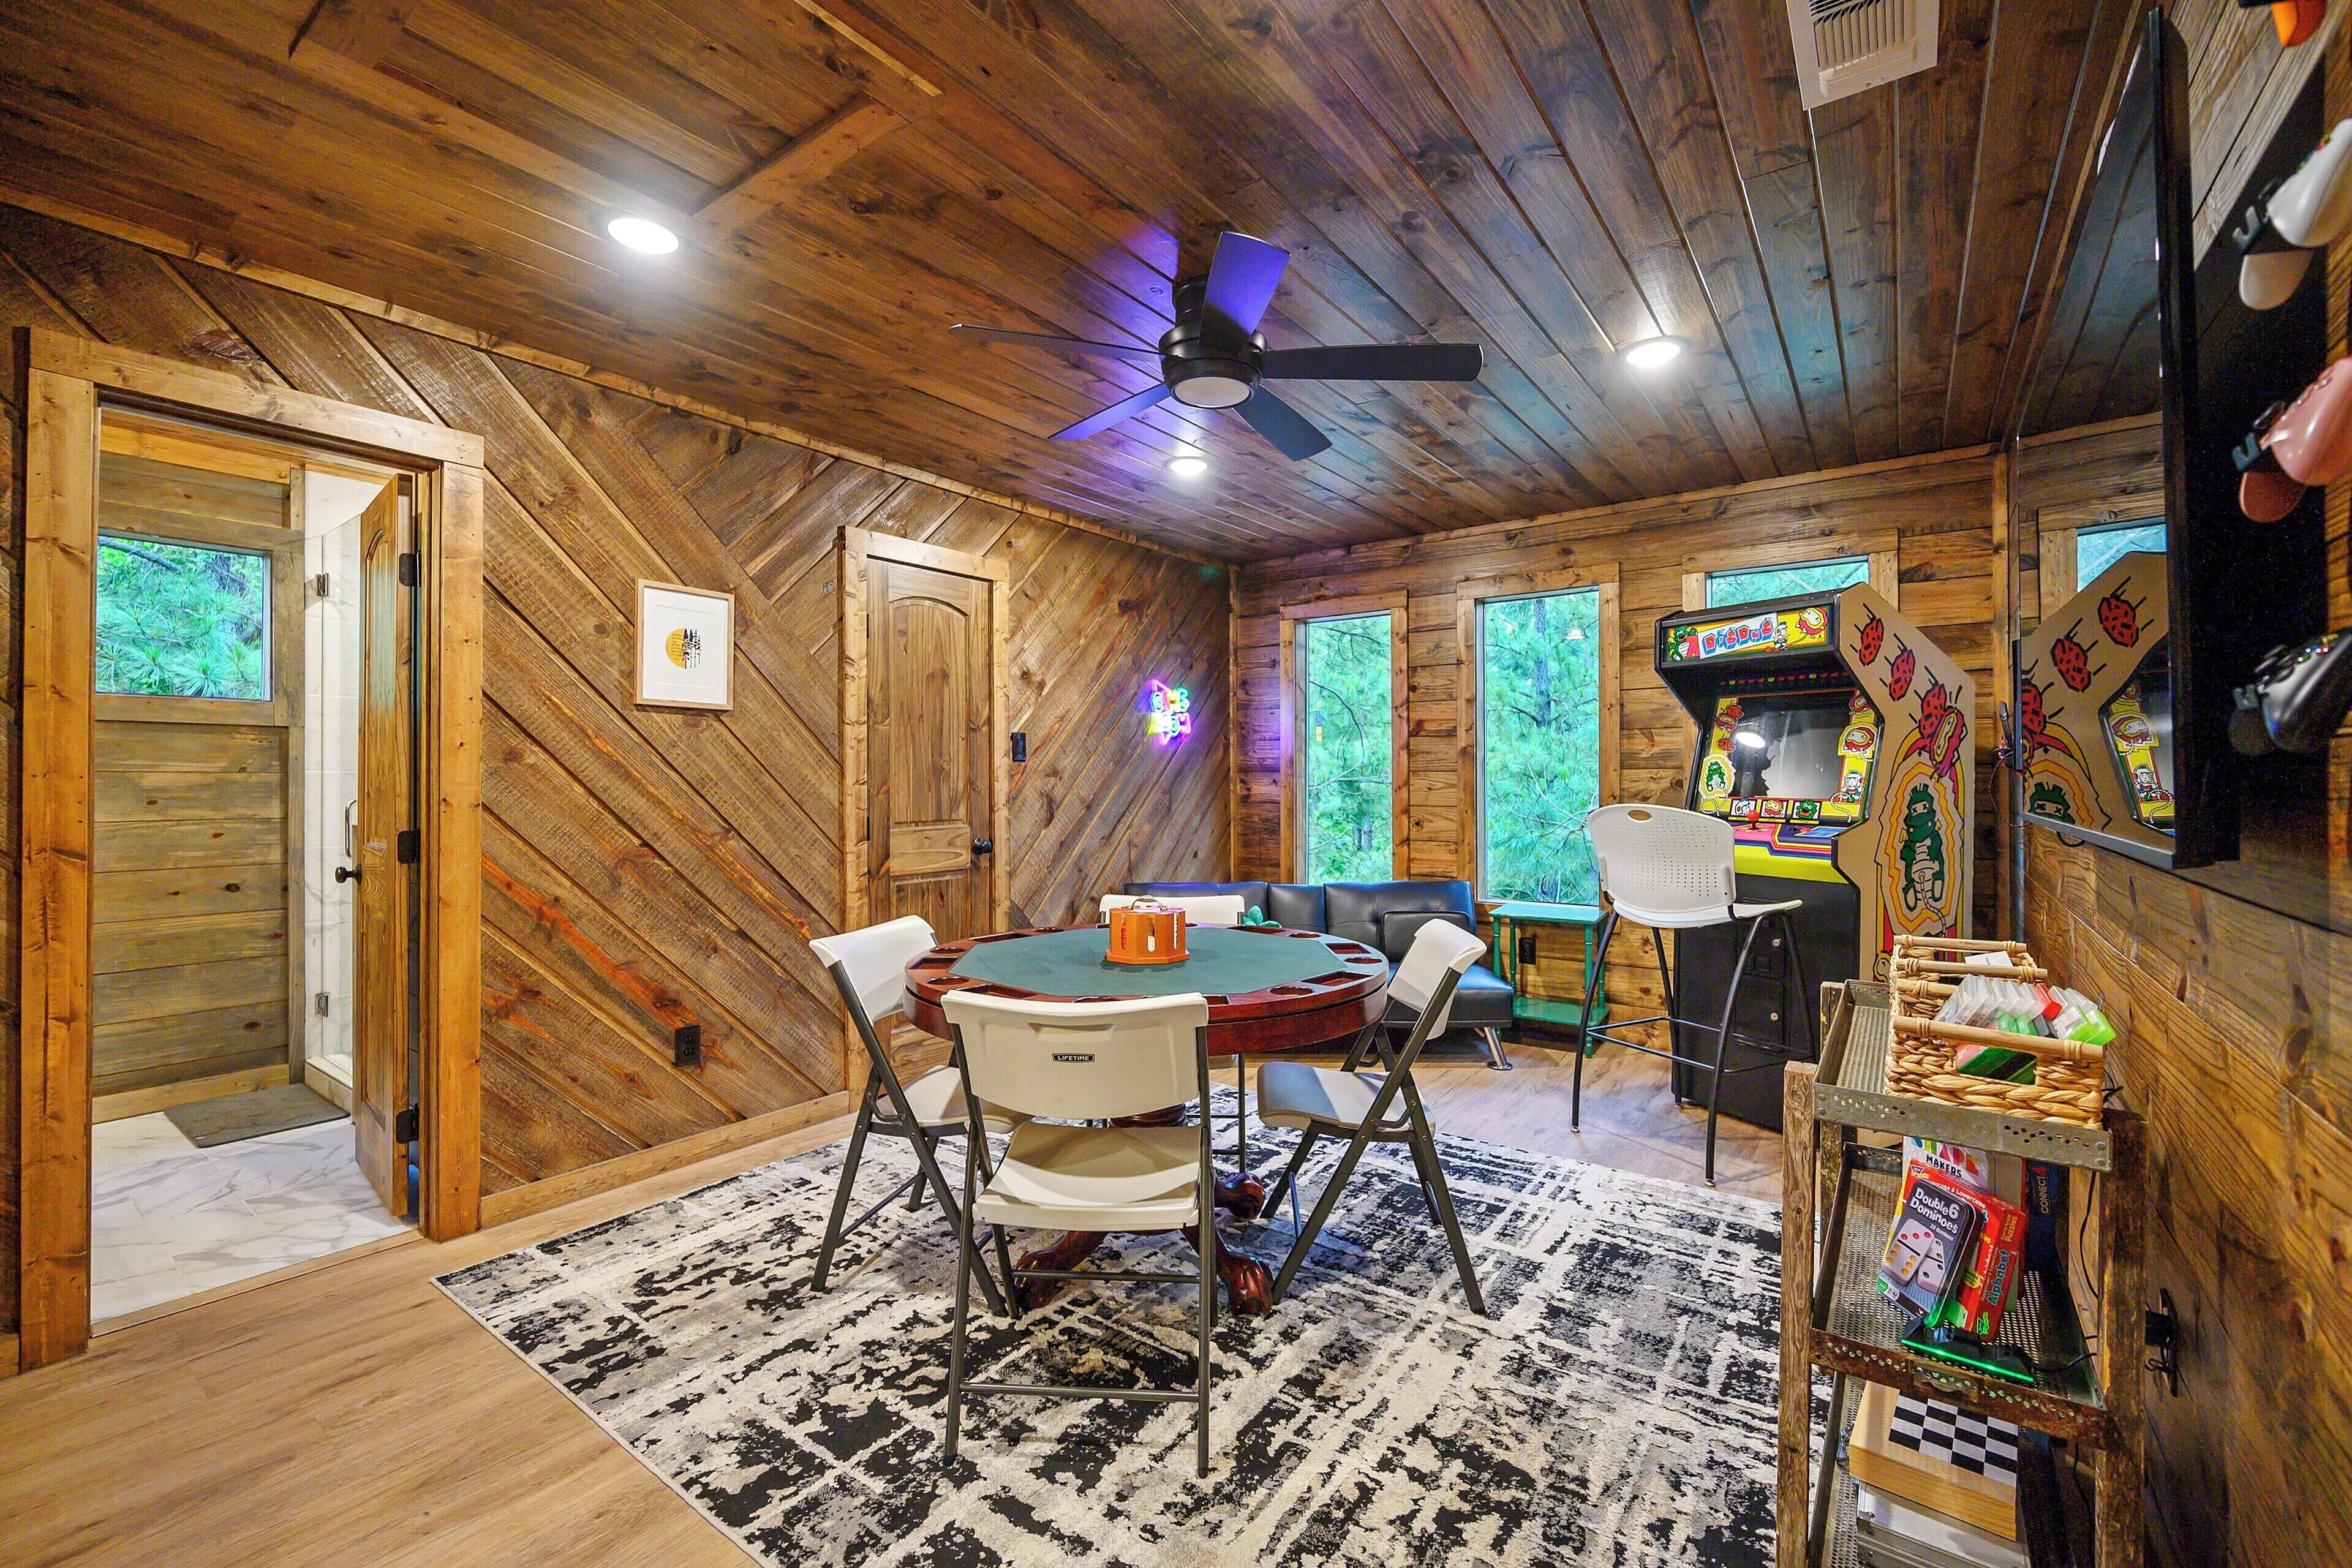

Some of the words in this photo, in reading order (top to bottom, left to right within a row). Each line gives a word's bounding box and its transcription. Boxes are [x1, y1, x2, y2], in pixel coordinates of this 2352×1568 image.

[1926, 1154, 1962, 1177] MAKERS
[2032, 1166, 2048, 1177] 4
[1915, 1187, 1949, 1215] Double
[1948, 1204, 1959, 1219] 6
[1956, 1188, 1986, 1208] Lowercase
[2037, 1175, 2049, 1213] CONNECT
[1910, 1196, 1958, 1234] Dominoes
[1986, 1250, 2011, 1306] Alphabet
